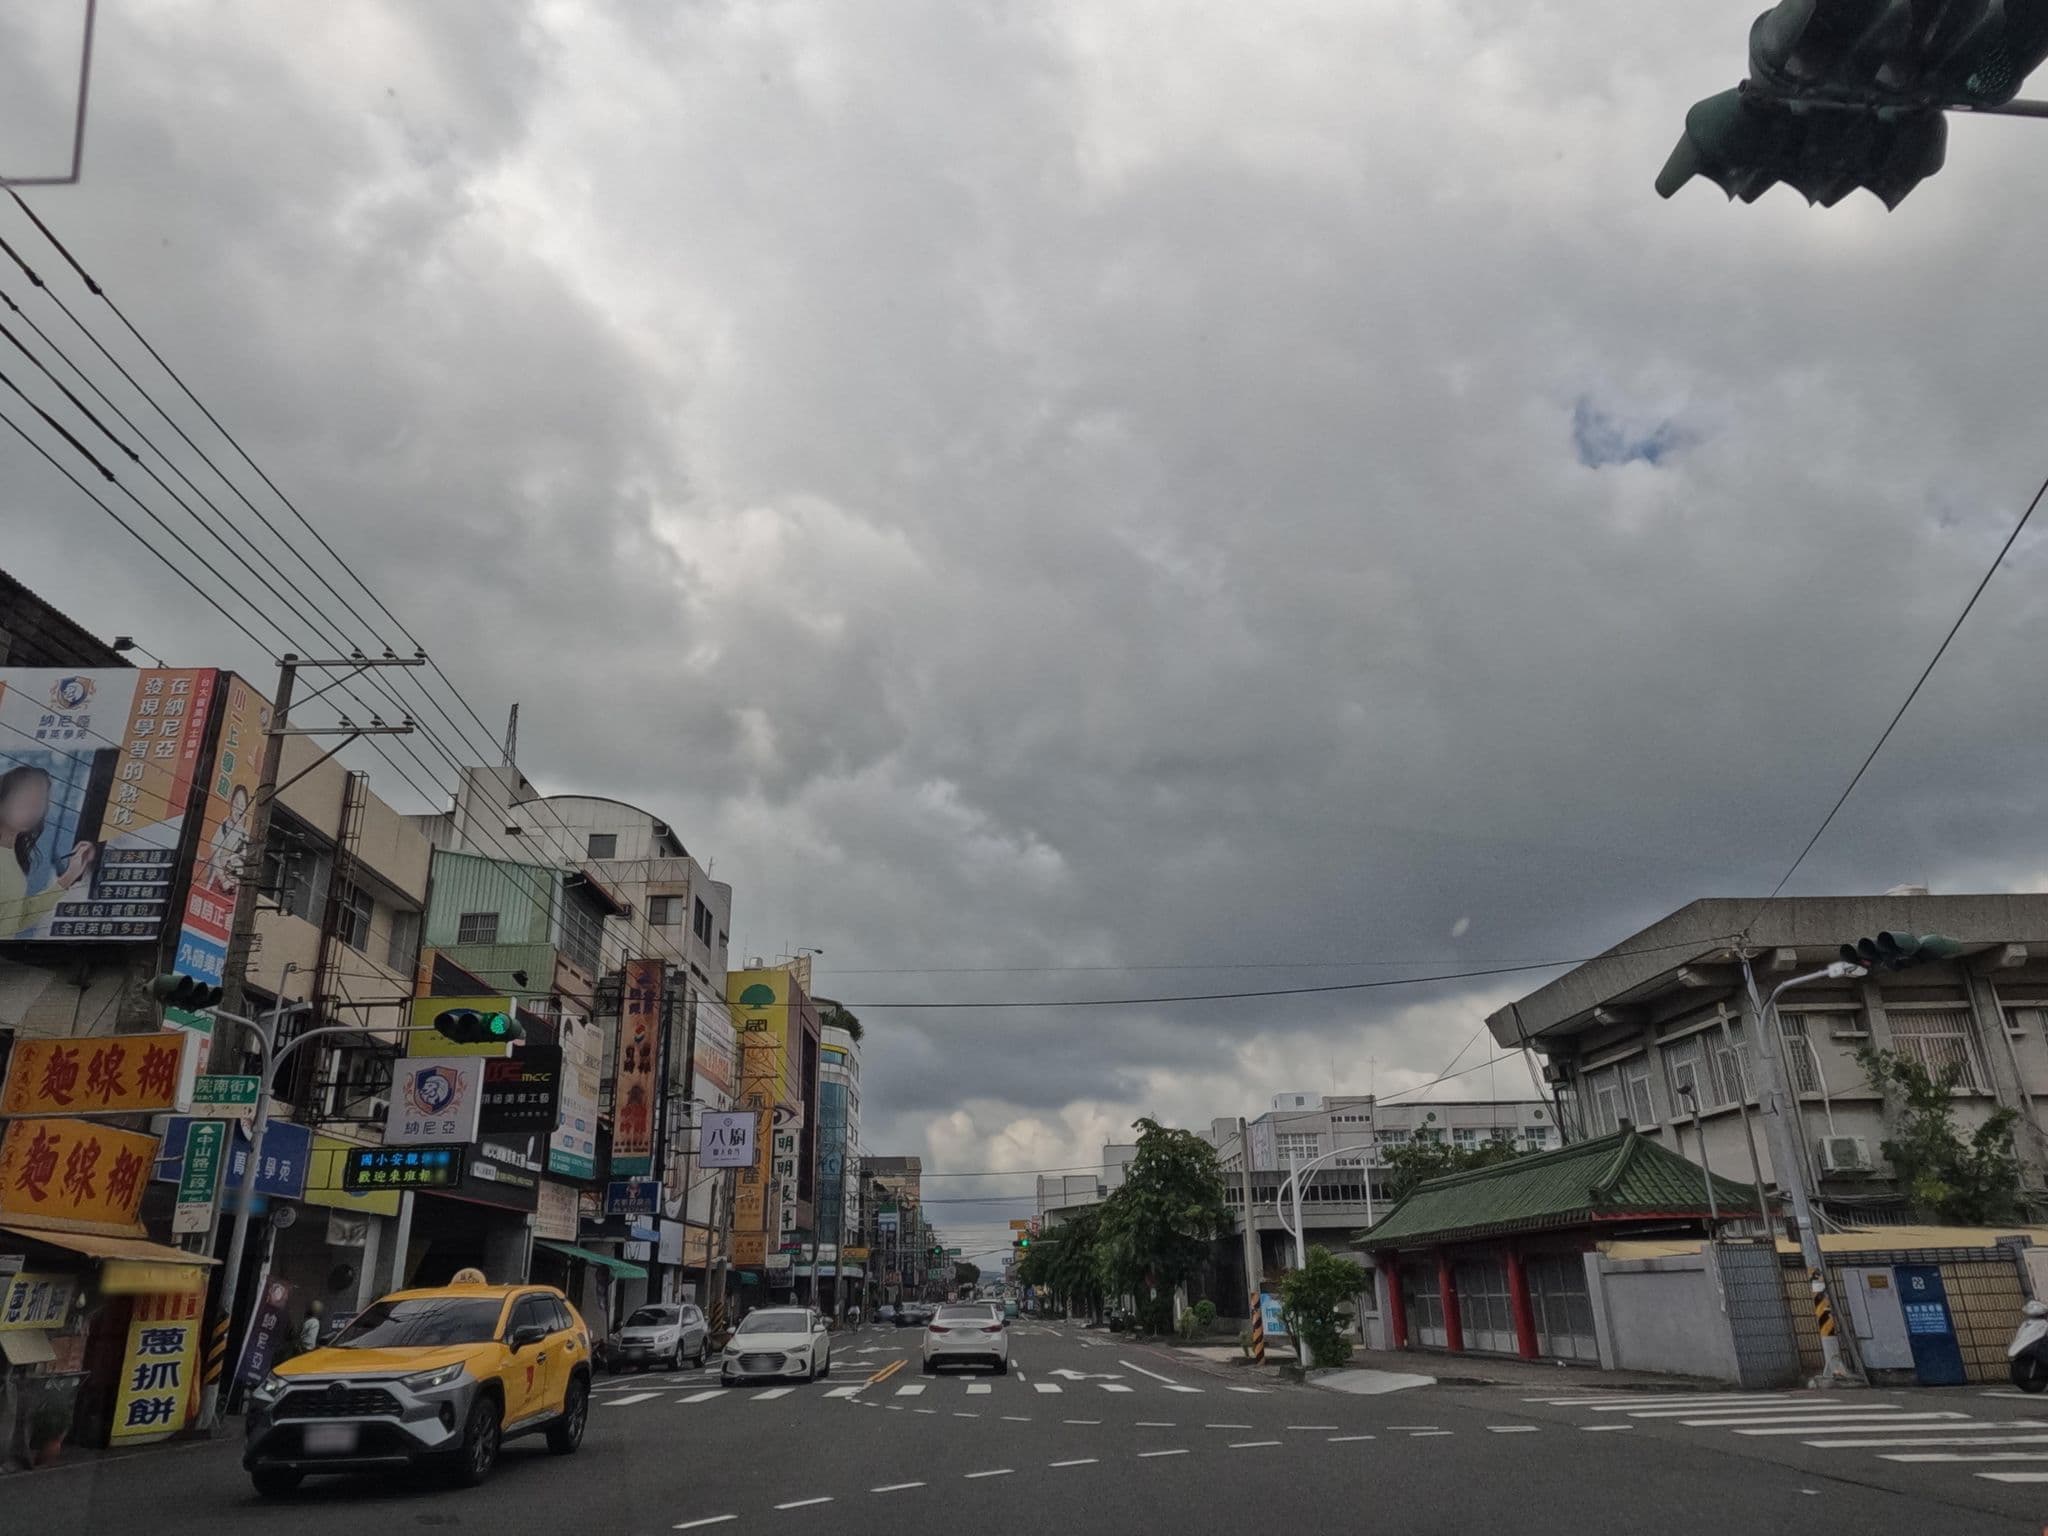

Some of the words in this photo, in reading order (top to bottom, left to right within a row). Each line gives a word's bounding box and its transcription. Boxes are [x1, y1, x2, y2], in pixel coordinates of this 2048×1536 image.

[153, 677, 193, 759] 在納尼亞
[404, 1120, 456, 1135] 納尼亞
[124, 1327, 187, 1428] 蔥抓餅
